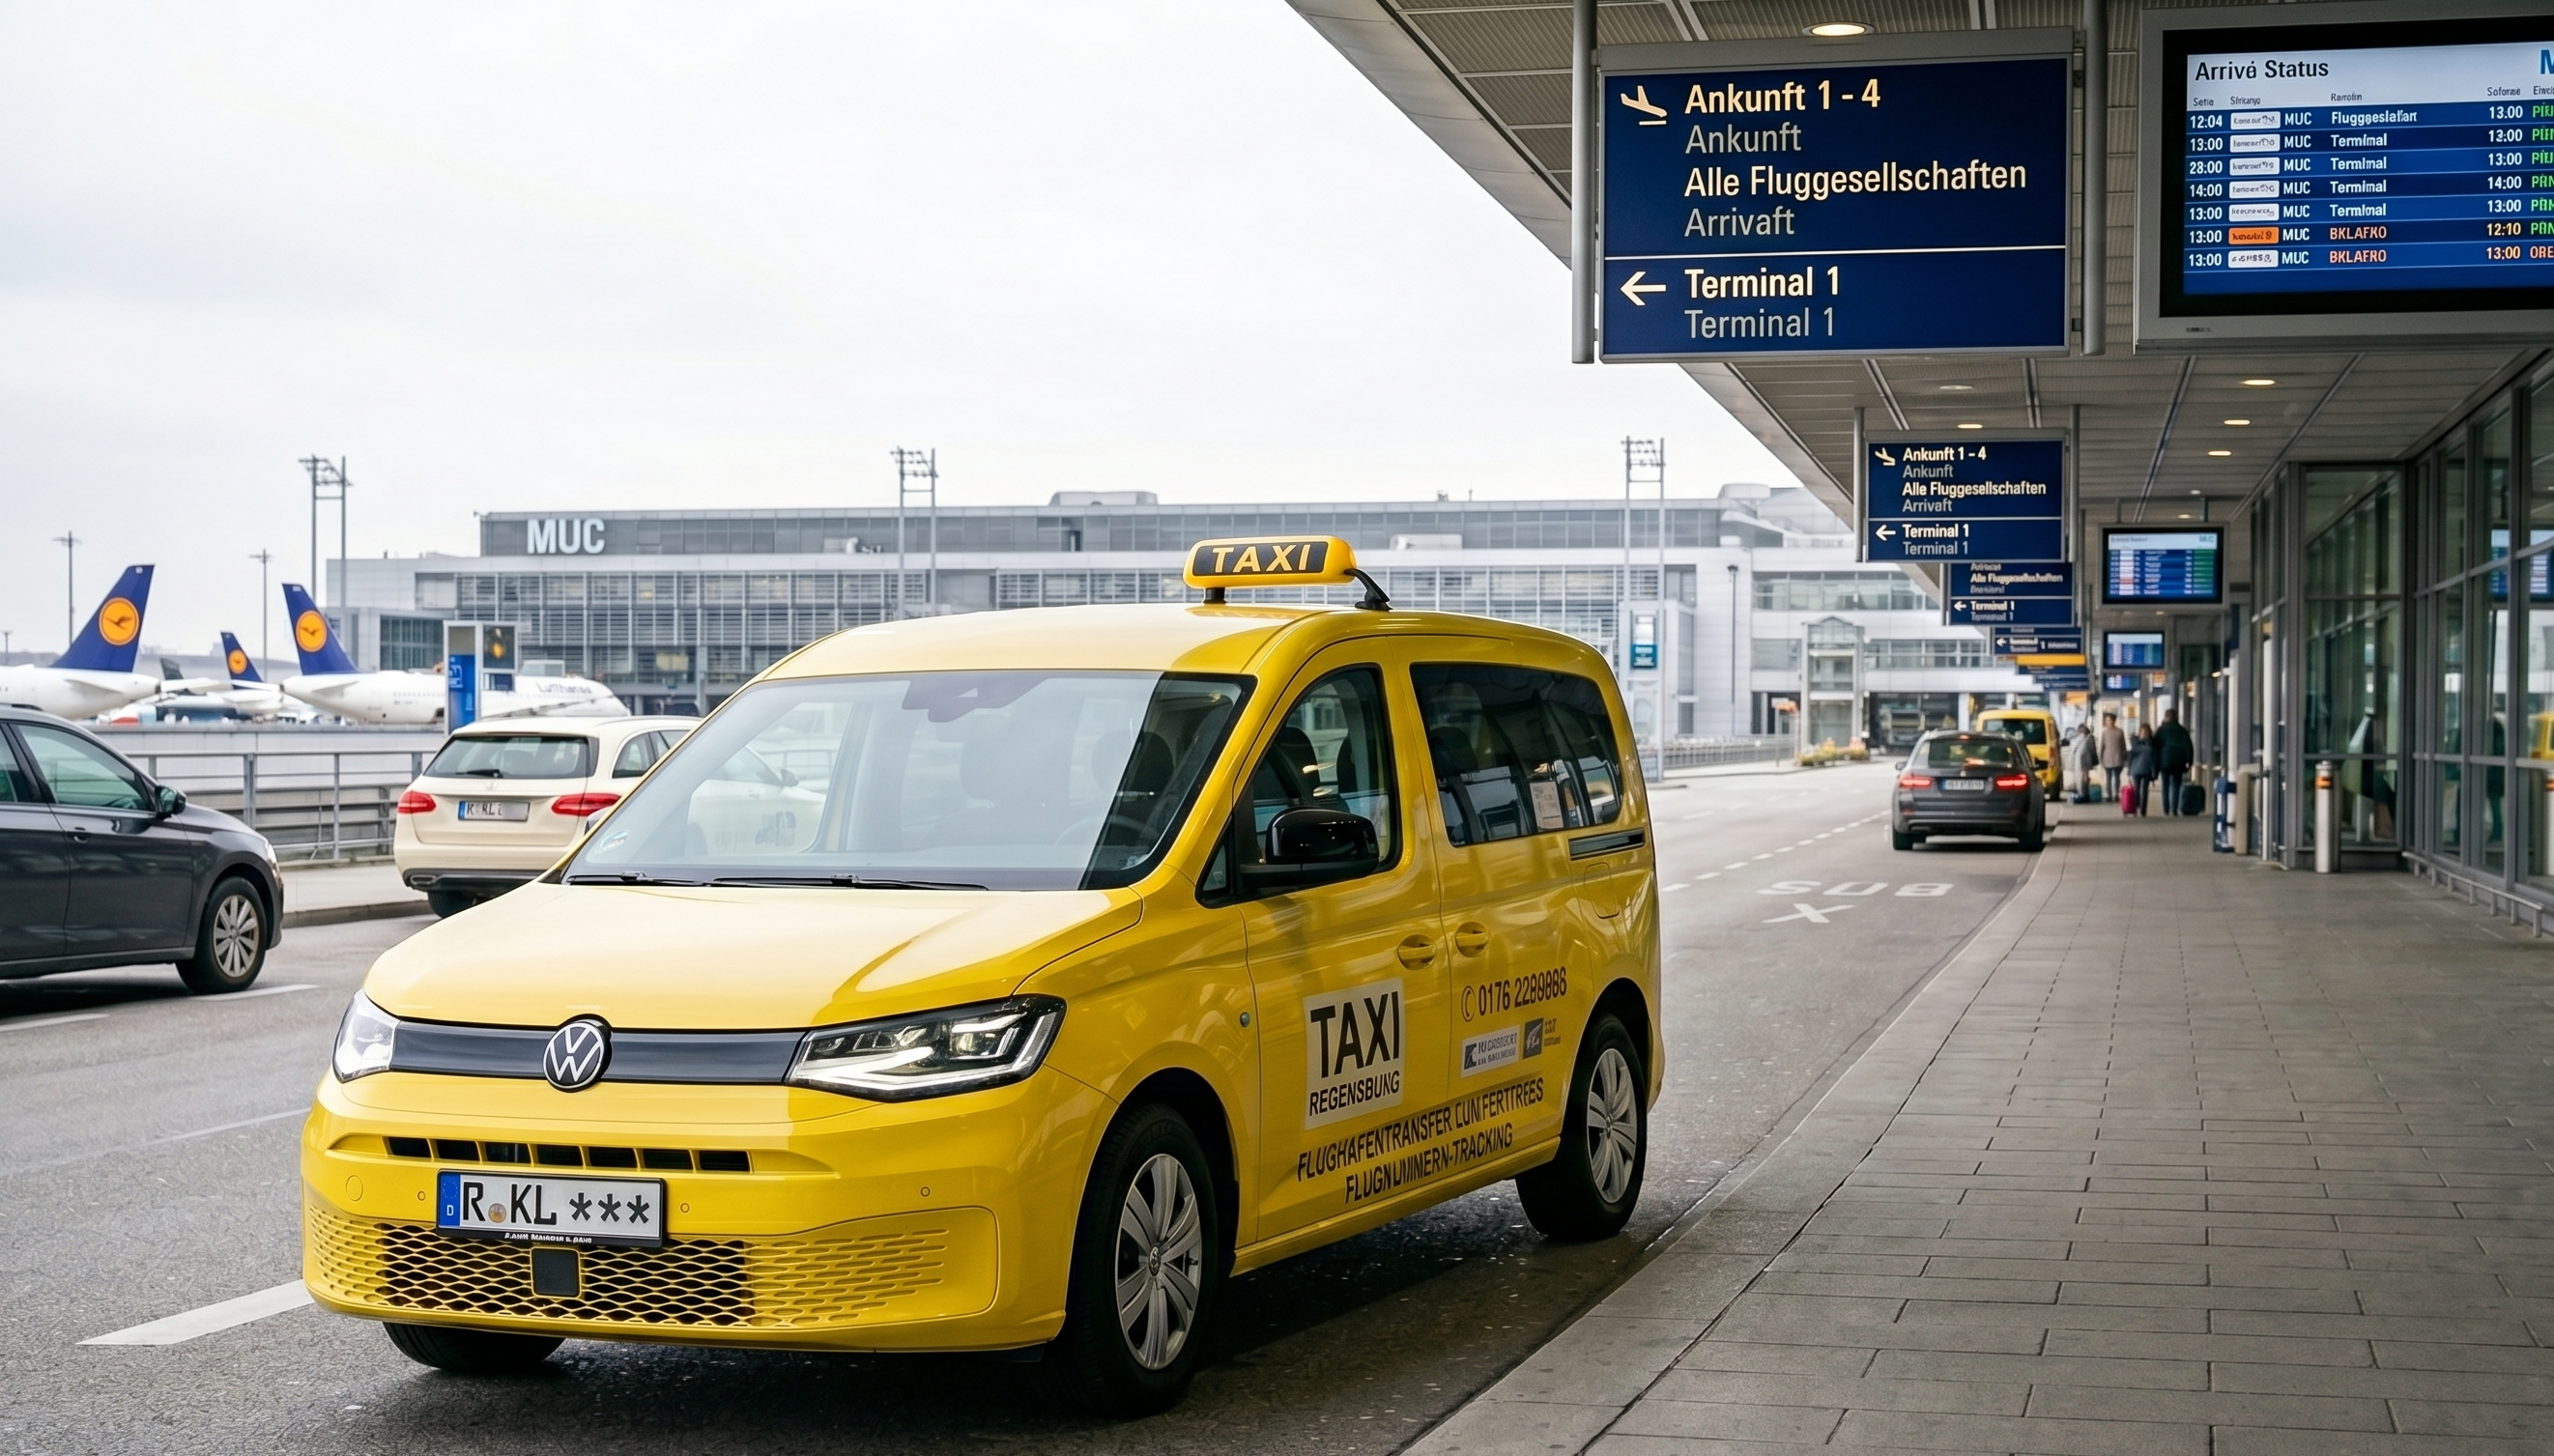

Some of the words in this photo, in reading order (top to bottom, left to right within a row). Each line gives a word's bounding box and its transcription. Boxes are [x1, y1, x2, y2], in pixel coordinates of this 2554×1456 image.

[2264, 60, 2329, 78] Status
[1684, 80, 1806, 115] Ankunft
[1818, 79, 1831, 110] 1
[1861, 78, 1881, 108] 4
[2190, 114, 2223, 128] 12:04
[2284, 112, 2312, 126] MUC
[2488, 105, 2524, 120] 13:00
[1684, 121, 1802, 155] Ankunft
[2190, 137, 2224, 152] 13:00
[2283, 134, 2311, 149] MUC
[2189, 160, 2224, 175] 28:00
[2283, 157, 2311, 172] MUC
[2487, 152, 2523, 166] 13:00
[1684, 165, 1740, 198] Alle
[1750, 158, 2027, 202] Fluggesellschaften
[2189, 183, 2223, 198] 14:00
[2282, 181, 2311, 195] MUC
[2487, 175, 2522, 189] 14:00
[2189, 206, 2223, 220] 13:00
[2282, 204, 2310, 218] MUC
[2486, 199, 2522, 213] 13:00
[1684, 206, 1795, 238] Arrivaft
[2189, 230, 2223, 243] 13:00
[2282, 227, 2310, 242] MUC
[2486, 221, 2522, 237] 12:10
[2188, 252, 2223, 267] 13:00
[2281, 250, 2310, 265] MUC
[2485, 245, 2521, 260] 13:00
[1684, 266, 1813, 300] Terminal
[1826, 265, 1839, 296] 1
[1684, 307, 1810, 339] Terminal
[1823, 306, 1834, 336] 1
[1902, 446, 1955, 462] Ankunft
[1958, 446, 1965, 461] 1
[1977, 445, 1987, 461] 4
[1902, 463, 1954, 478] Ankunft
[1902, 481, 1927, 497] Alle
[1930, 479, 2047, 500] Fluggesellschaften
[527, 517, 606, 555] MUC
[1902, 523, 1959, 538] Terminal
[1963, 524, 1969, 537] 1
[1212, 544, 1311, 574] TAXI
[1902, 540, 1958, 556] Terminal
[1963, 541, 1968, 555] 1
[1478, 979, 1511, 1017] 0176
[1309, 990, 1399, 1080] TAXI
[1297, 1106, 1453, 1183] FLUGHAFENTRANSFER
[446, 1205, 454, 1216] D
[462, 1182, 486, 1221] R
[510, 1184, 558, 1225] KL
